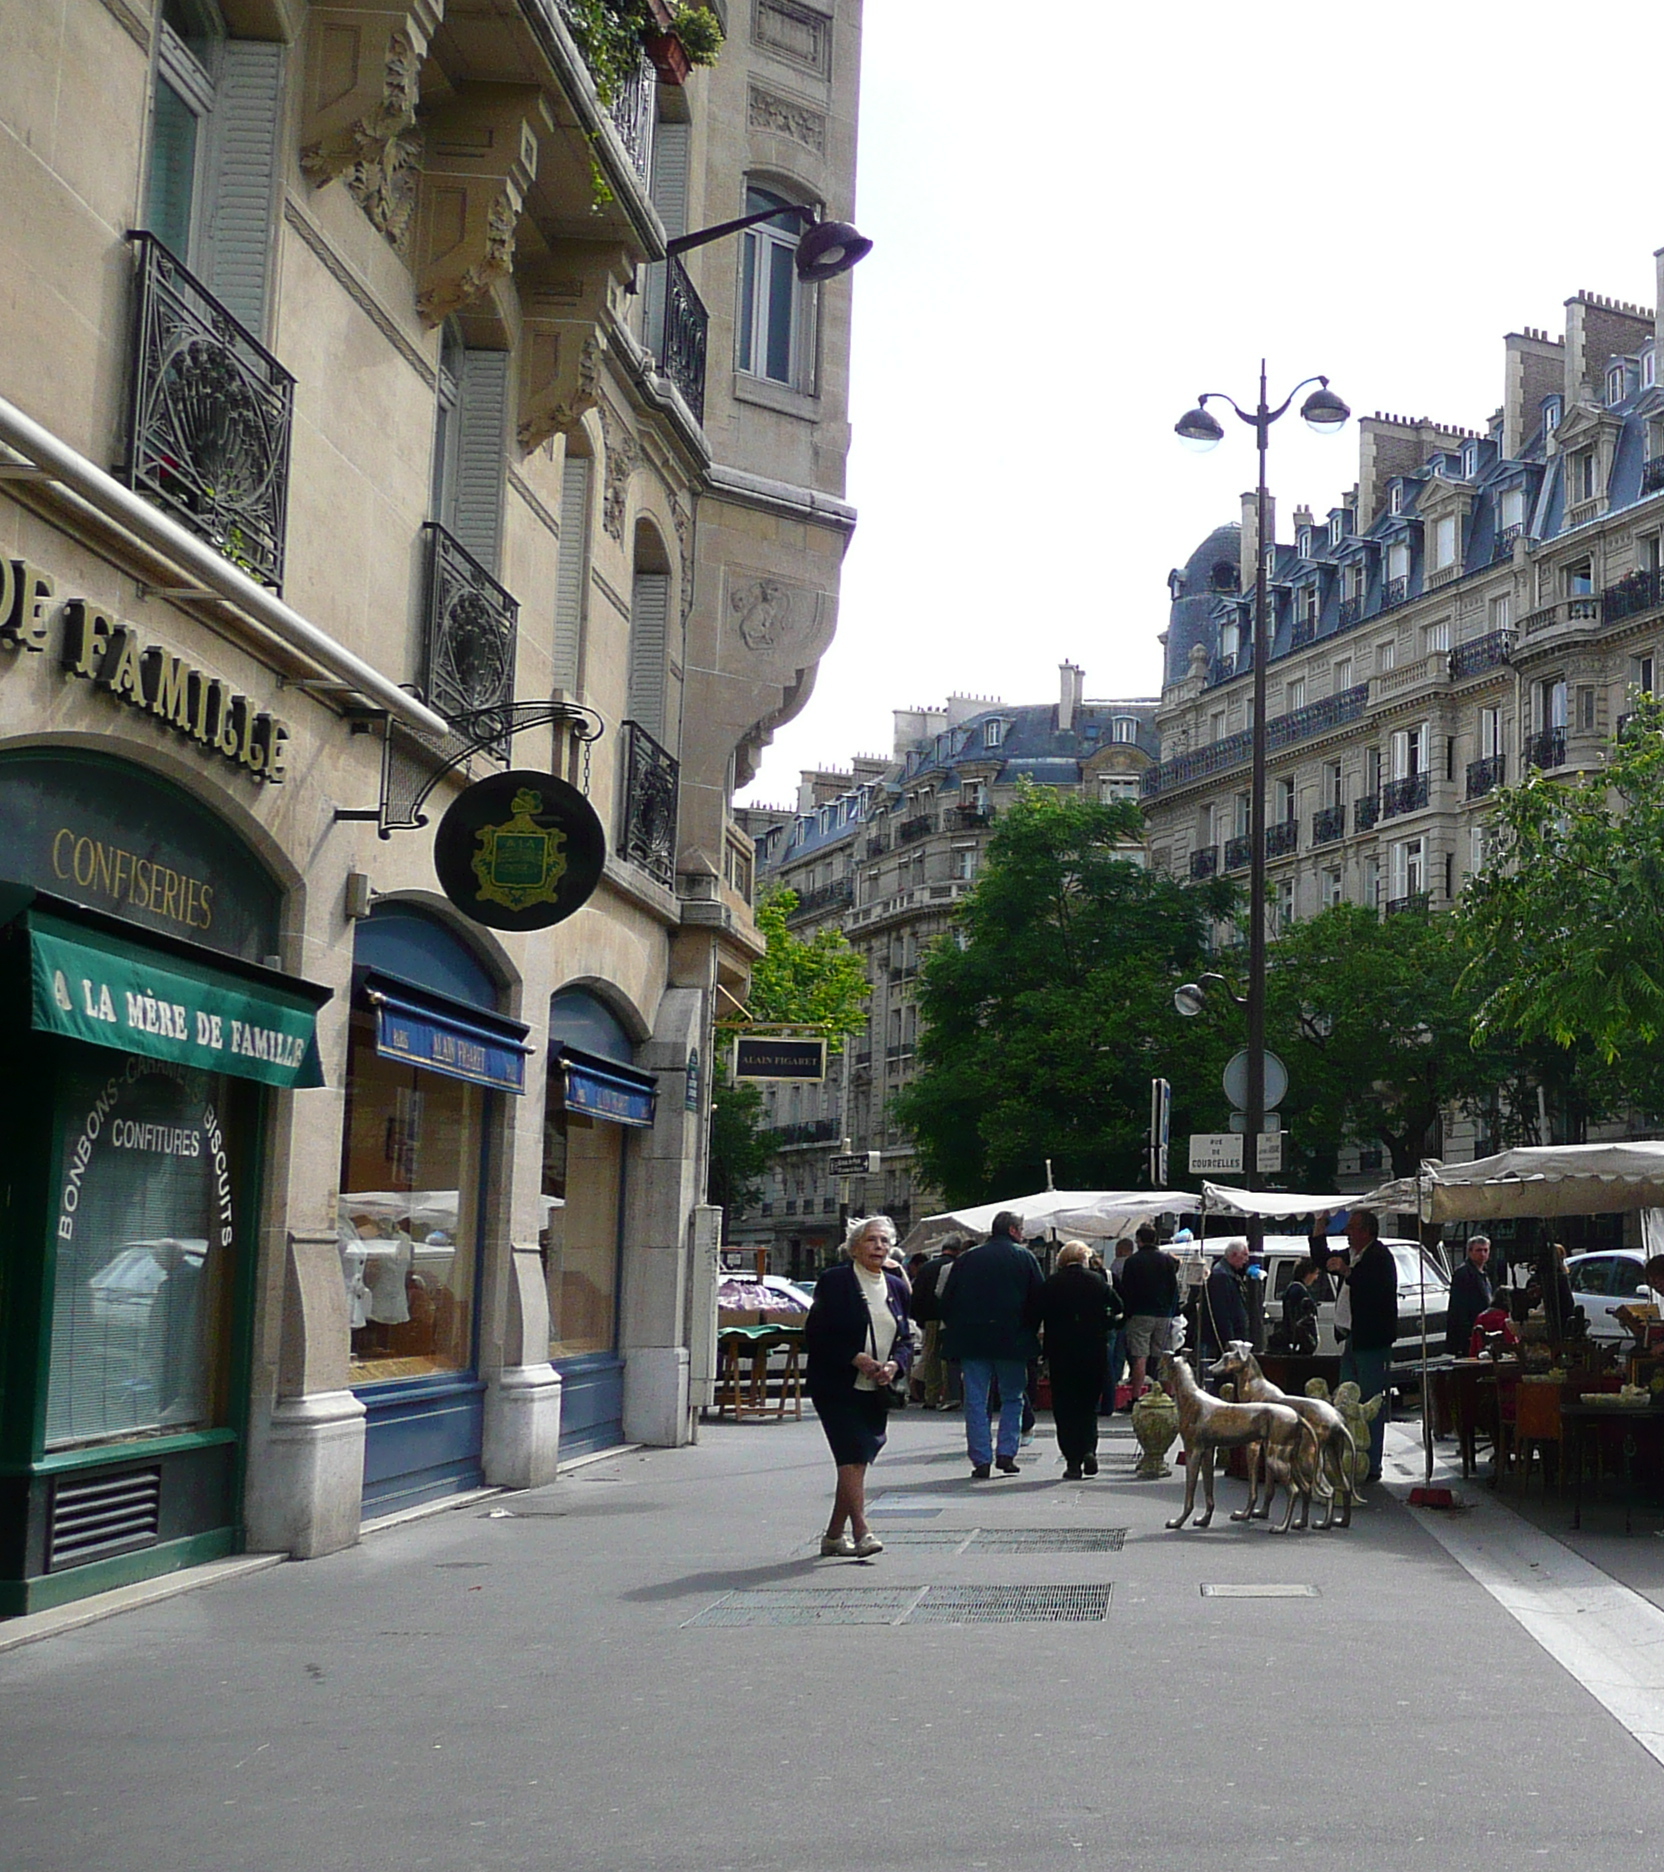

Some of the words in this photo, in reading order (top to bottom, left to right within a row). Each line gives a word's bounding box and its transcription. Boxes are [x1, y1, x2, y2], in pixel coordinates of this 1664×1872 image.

[65, 598, 290, 784] FAMILLE
[53, 828, 213, 930] CONFISERIES
[54, 969, 73, 1011] A
[82, 979, 117, 1022] LA
[125, 988, 188, 1041] MÈRE
[196, 1011, 224, 1050] DE
[230, 1020, 304, 1068] FAMILLE
[743, 1056, 772, 1066] ALAIN
[774, 1056, 819, 1067] FIGARET
[112, 1118, 201, 1157] CONFITURES
[1210, 1138, 1223, 1146] RUE
[1212, 1148, 1221, 1156] DE
[203, 1104, 233, 1247] BISCUITS
[1192, 1159, 1240, 1168] COURCELLES
